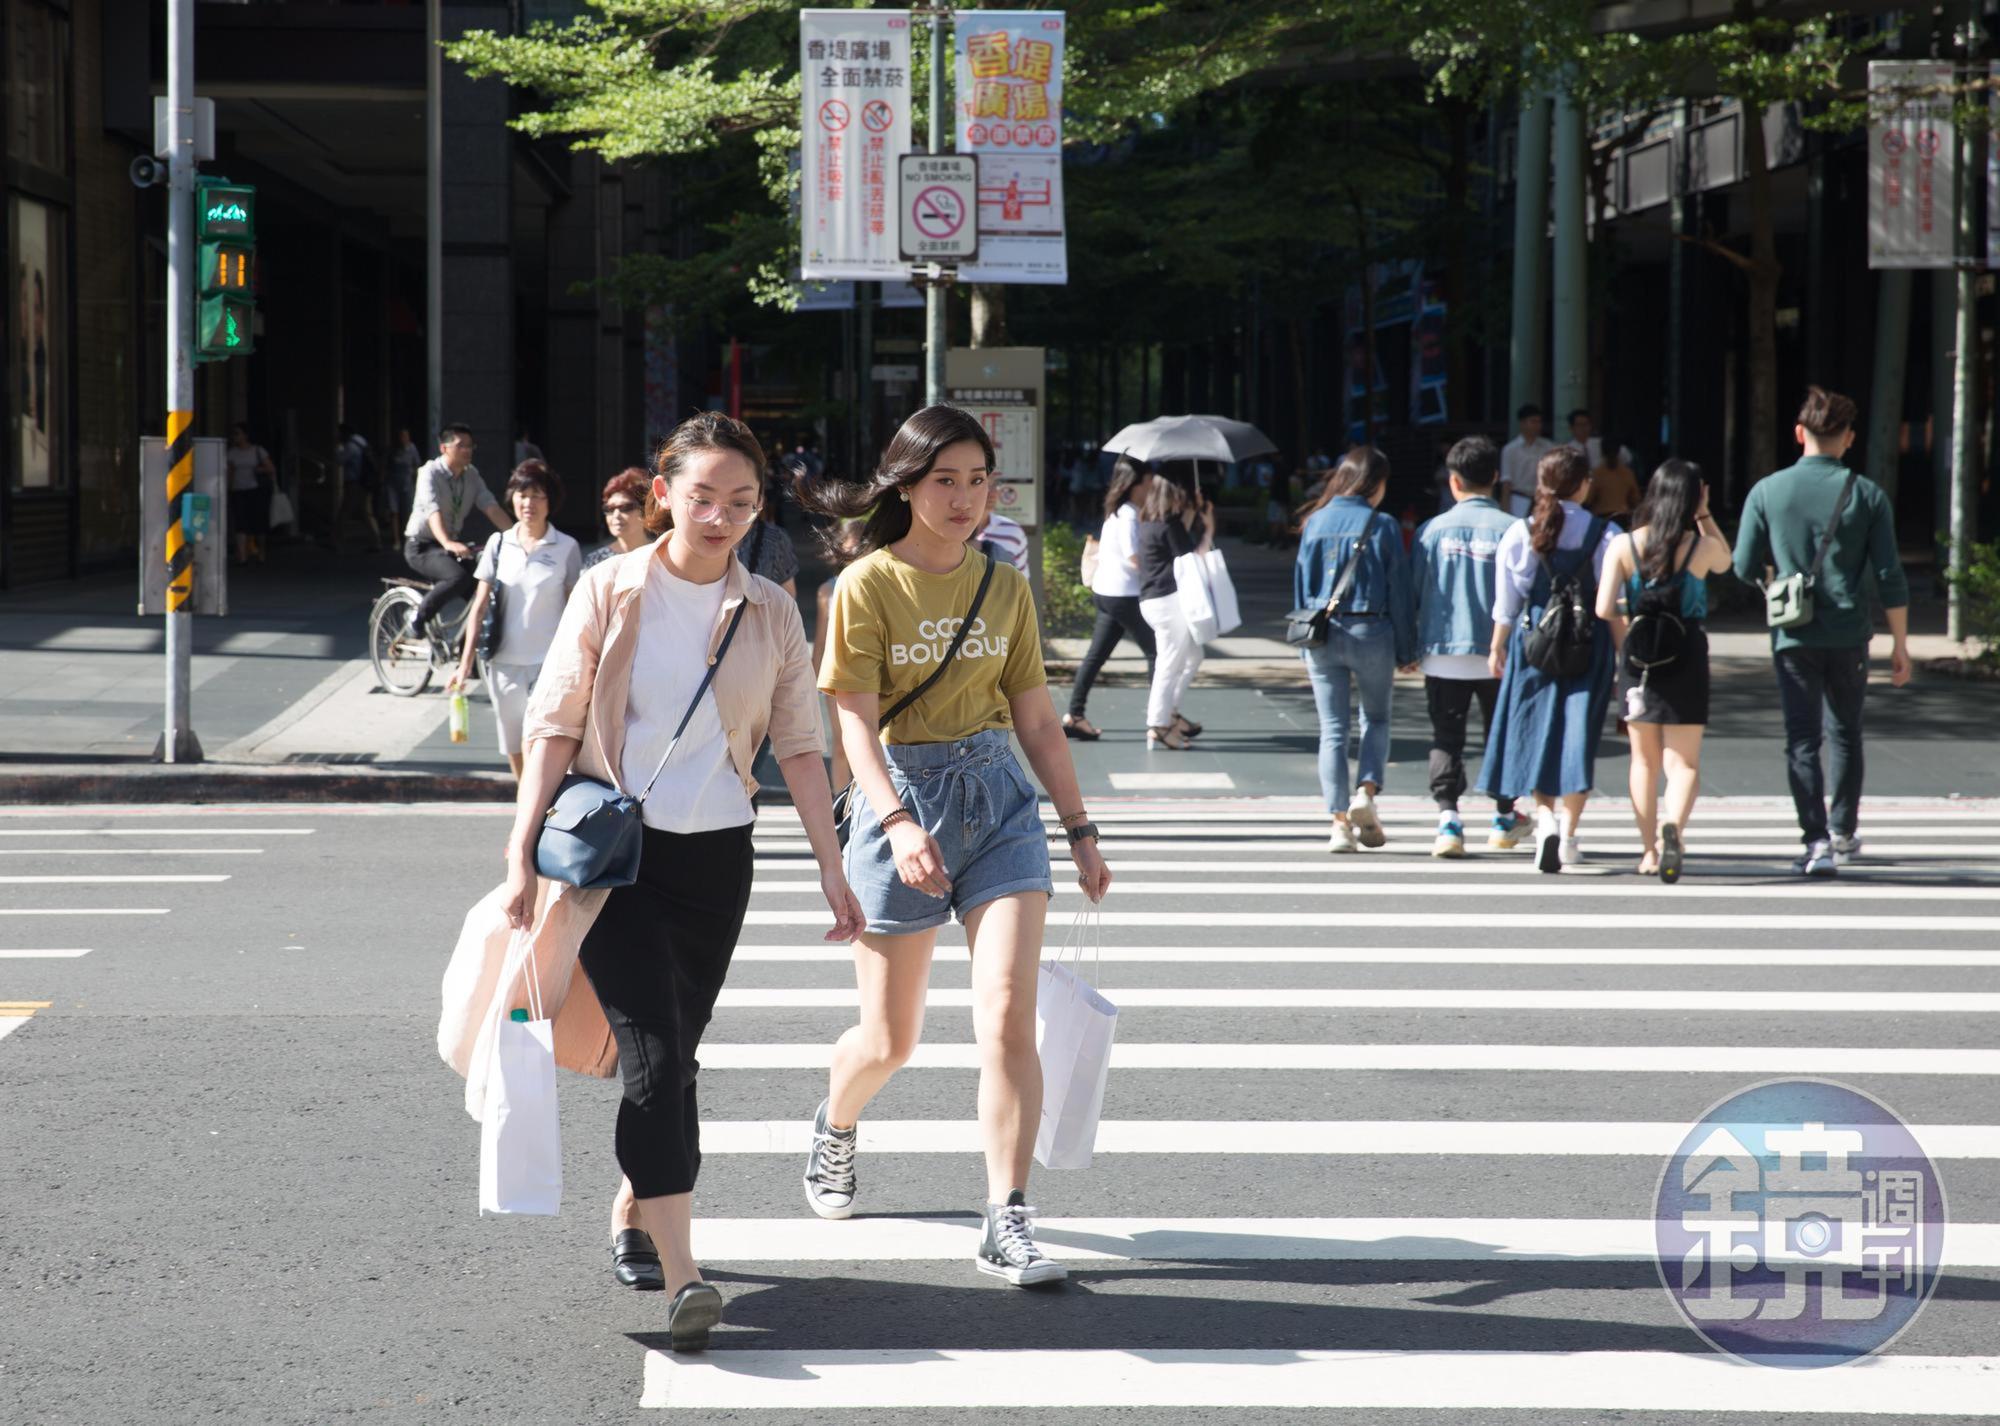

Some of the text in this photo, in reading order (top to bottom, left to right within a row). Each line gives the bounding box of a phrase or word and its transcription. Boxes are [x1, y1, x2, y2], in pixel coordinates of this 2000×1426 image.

[808, 40, 890, 60] 香堤廣場
[967, 30, 1053, 83] 香堤
[820, 66, 904, 88] 全面禁菸
[973, 82, 1049, 121] 廣場
[905, 174, 972, 182] NO SMOKING
[918, 161, 961, 172] 香堤廣場
[219, 252, 246, 287] 11
[890, 635, 1008, 665] BOUQUE
